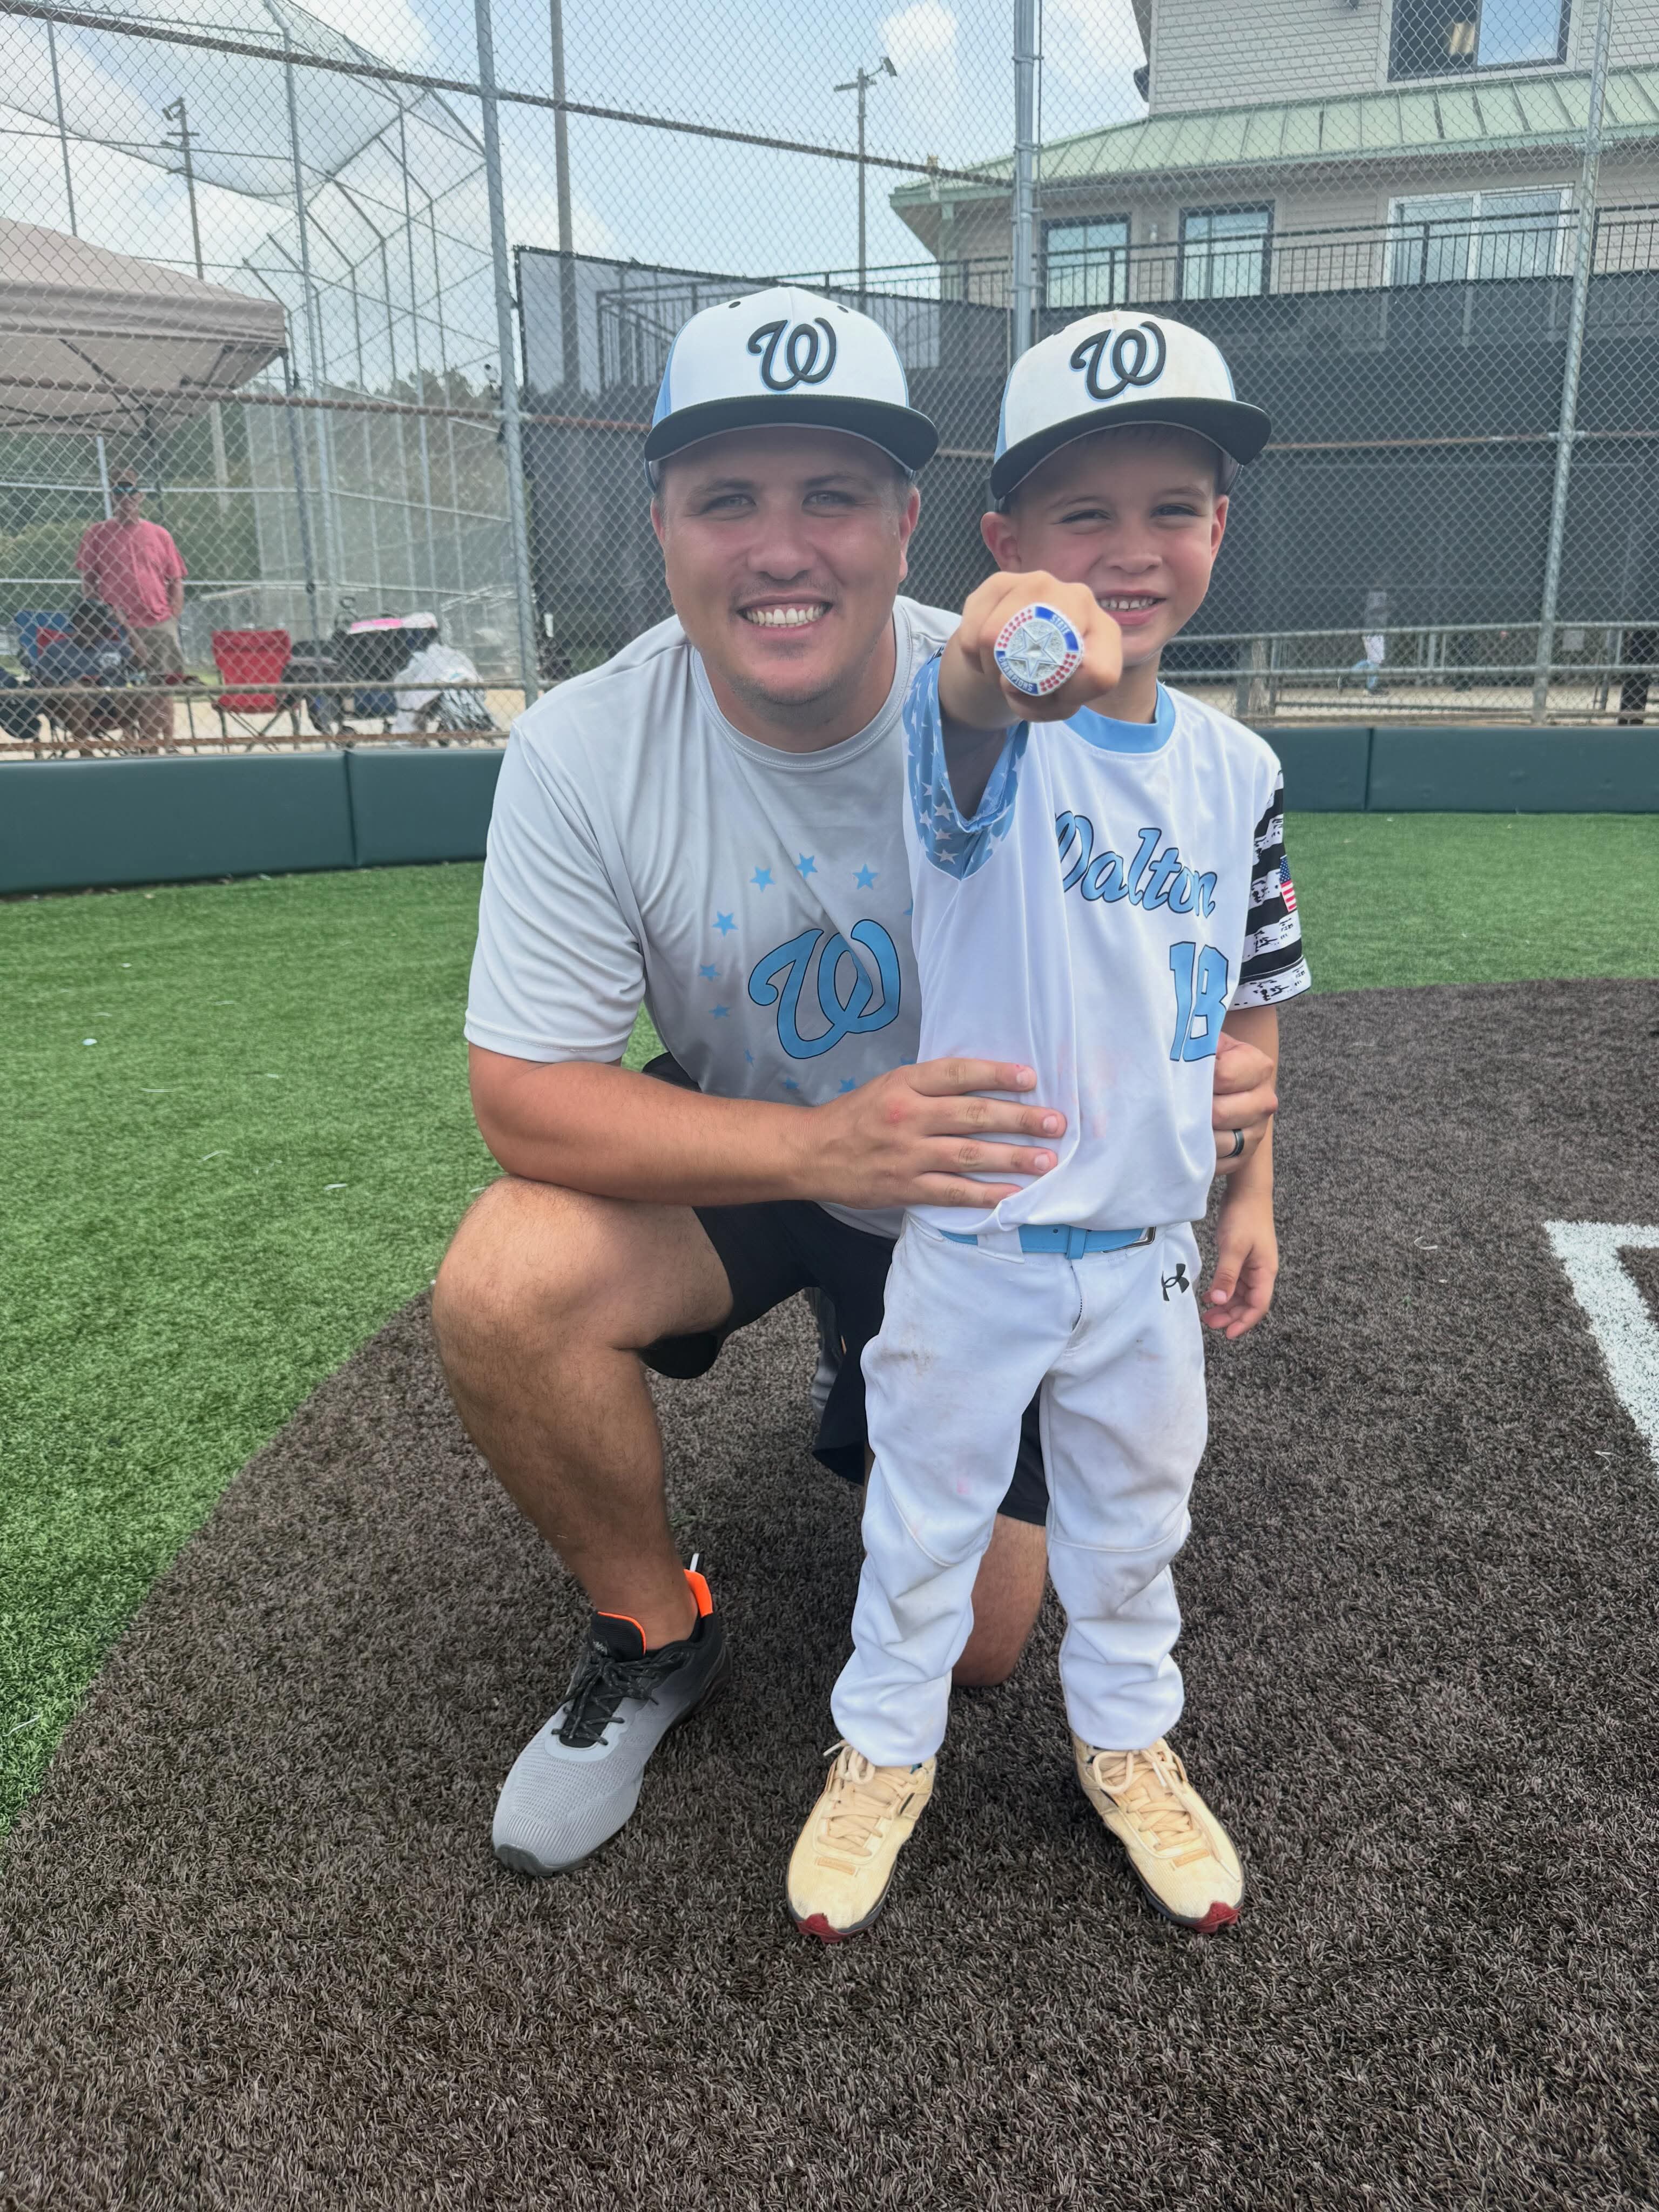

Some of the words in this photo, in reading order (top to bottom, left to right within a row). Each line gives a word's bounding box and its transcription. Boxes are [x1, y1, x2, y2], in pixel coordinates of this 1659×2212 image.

[746, 317, 837, 393] W
[1069, 321, 1167, 401] W
[997, 656, 1033, 692] CHAMPIONS
[748, 919, 901, 1060] W
[1170, 941, 1229, 1062] 18
